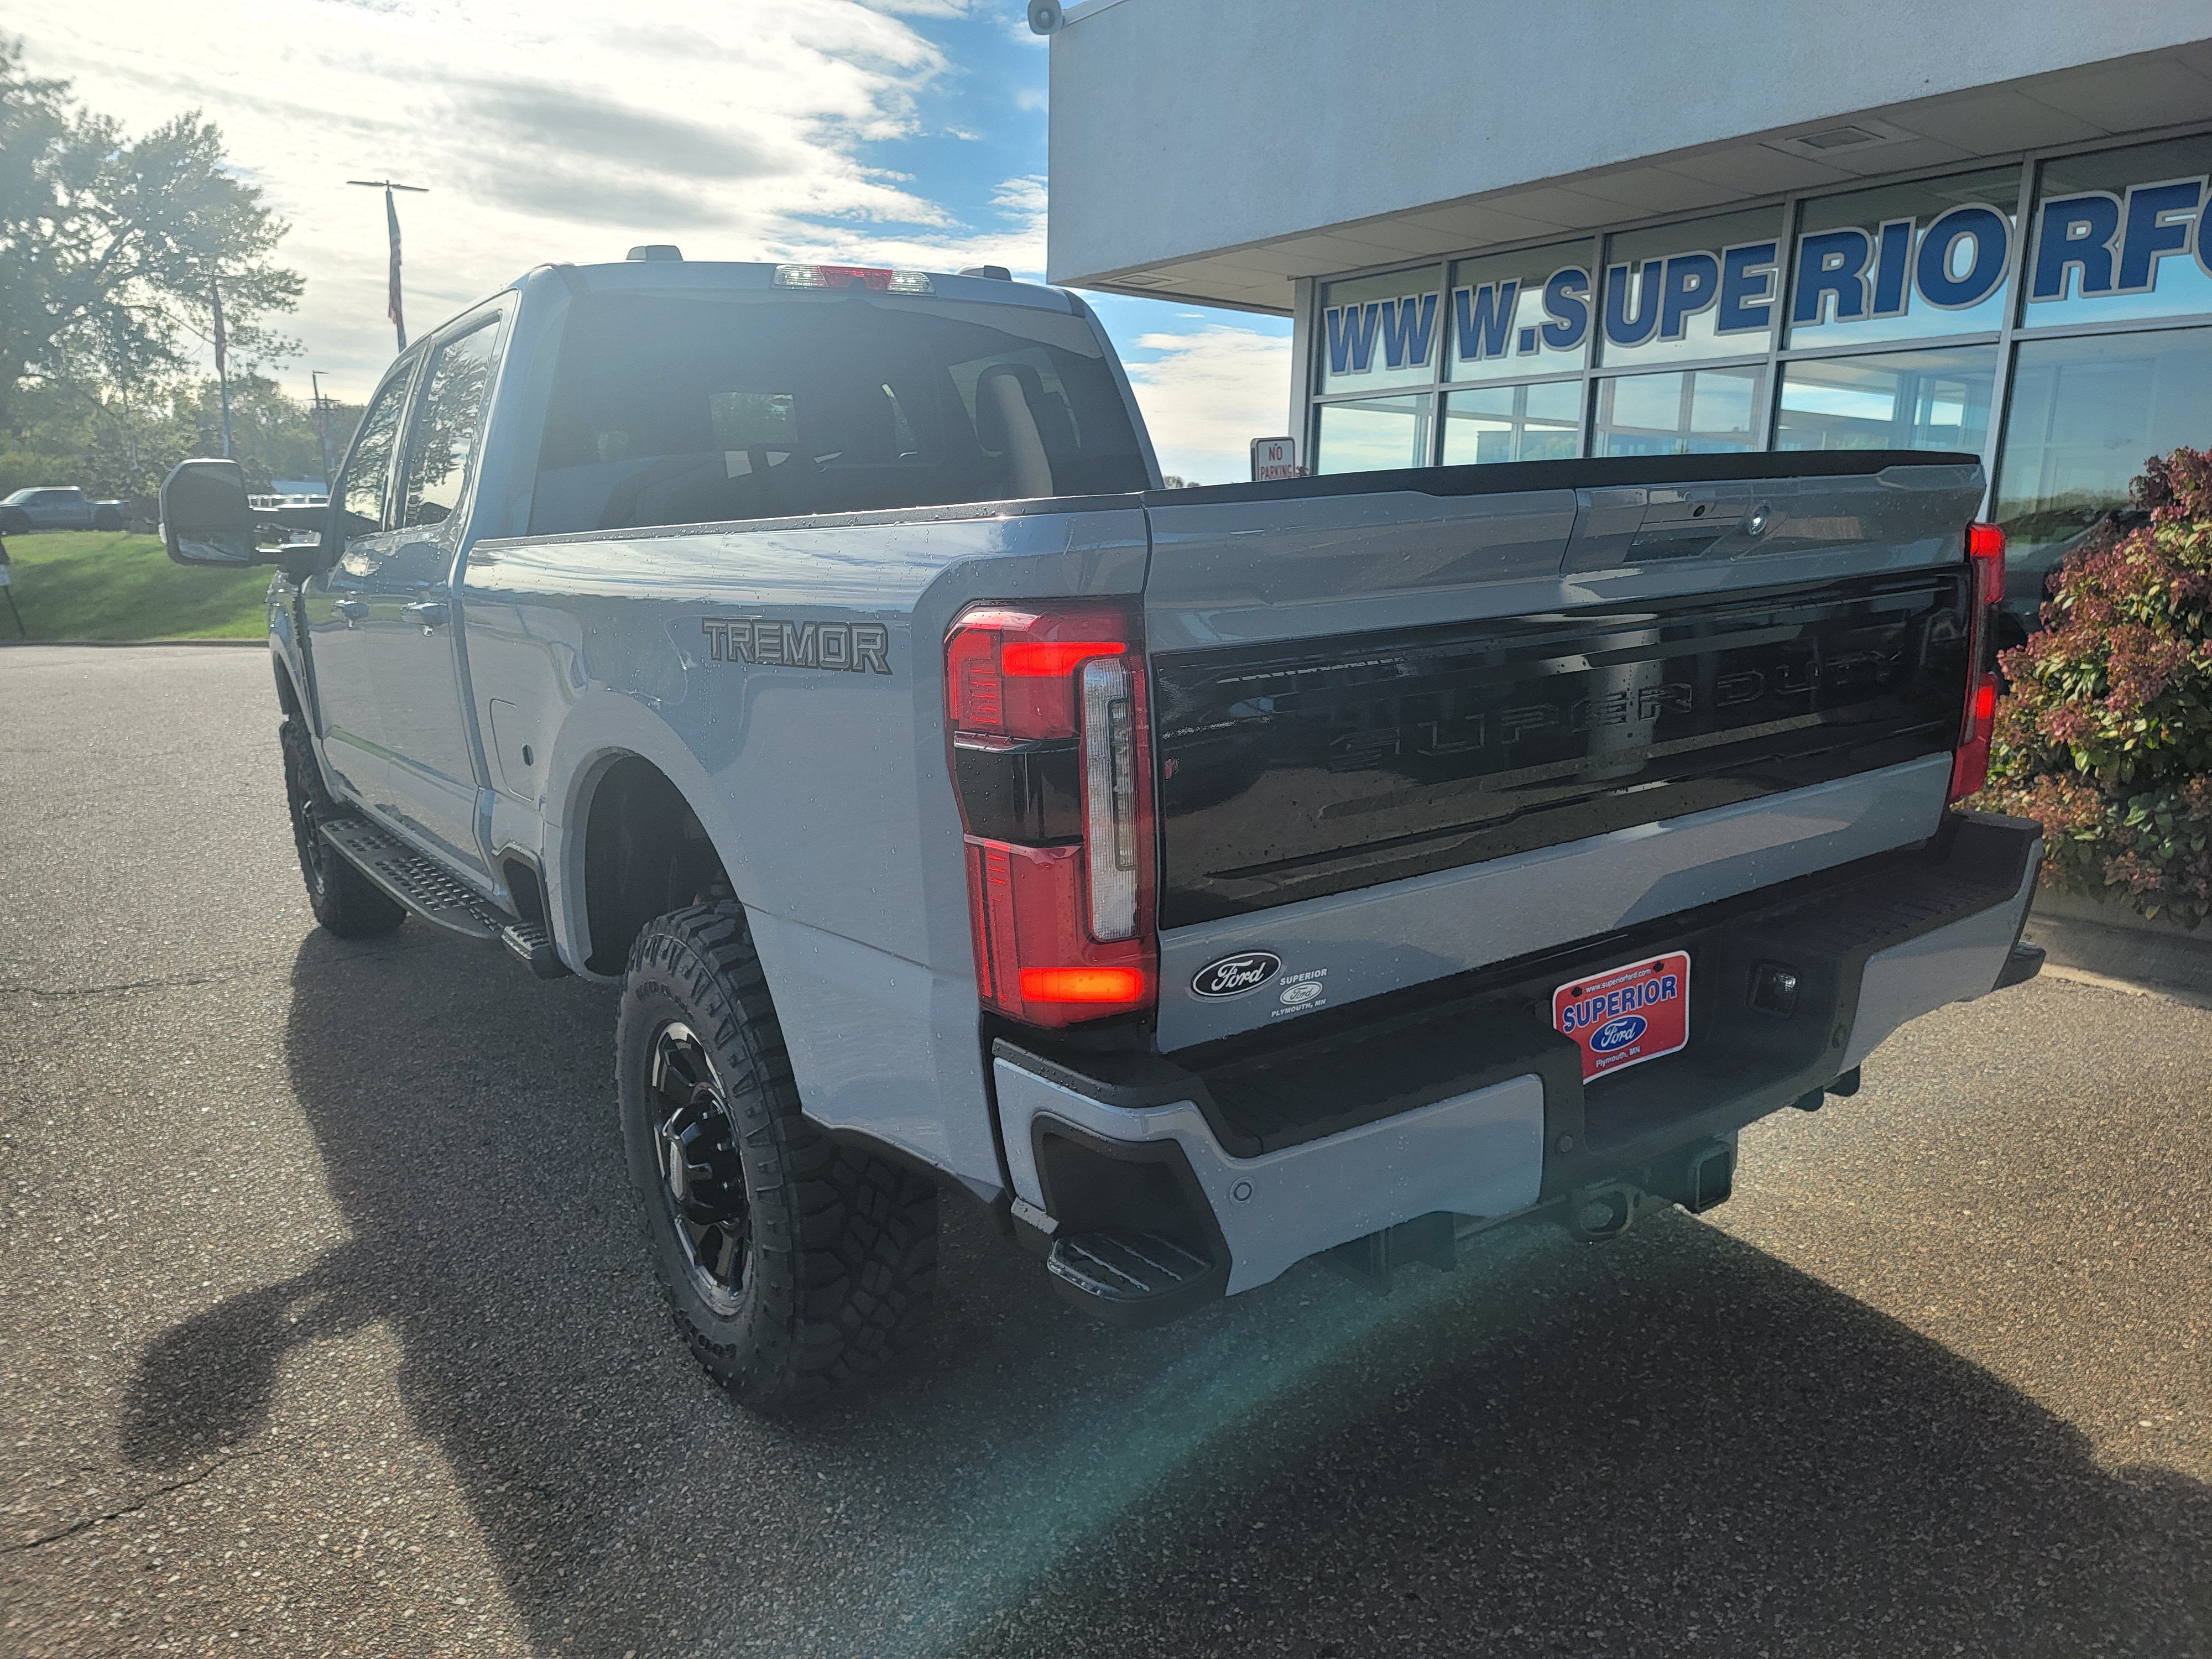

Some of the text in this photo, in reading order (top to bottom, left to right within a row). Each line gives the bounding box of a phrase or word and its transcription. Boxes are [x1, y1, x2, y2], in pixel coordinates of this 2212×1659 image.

[1323, 174, 2212, 376] WWW.SUPERIORF
[1269, 446, 1282, 461] NO
[1260, 465, 1292, 480] PARKING
[702, 618, 893, 675] TREMOR
[1329, 650, 1903, 771] SUPER DUTY
[1211, 959, 1267, 992] Ford
[1280, 968, 1327, 986] SUPERIOR
[1585, 968, 1651, 994] www.superiorford.com
[1290, 986, 1314, 1000] Ford
[1563, 974, 1678, 1034] SUPERIOR
[1271, 998, 1326, 1018] PLYMOUTH, MN
[1600, 1020, 1637, 1047] Ford
[1595, 1046, 1641, 1068] Plymouth, MN
